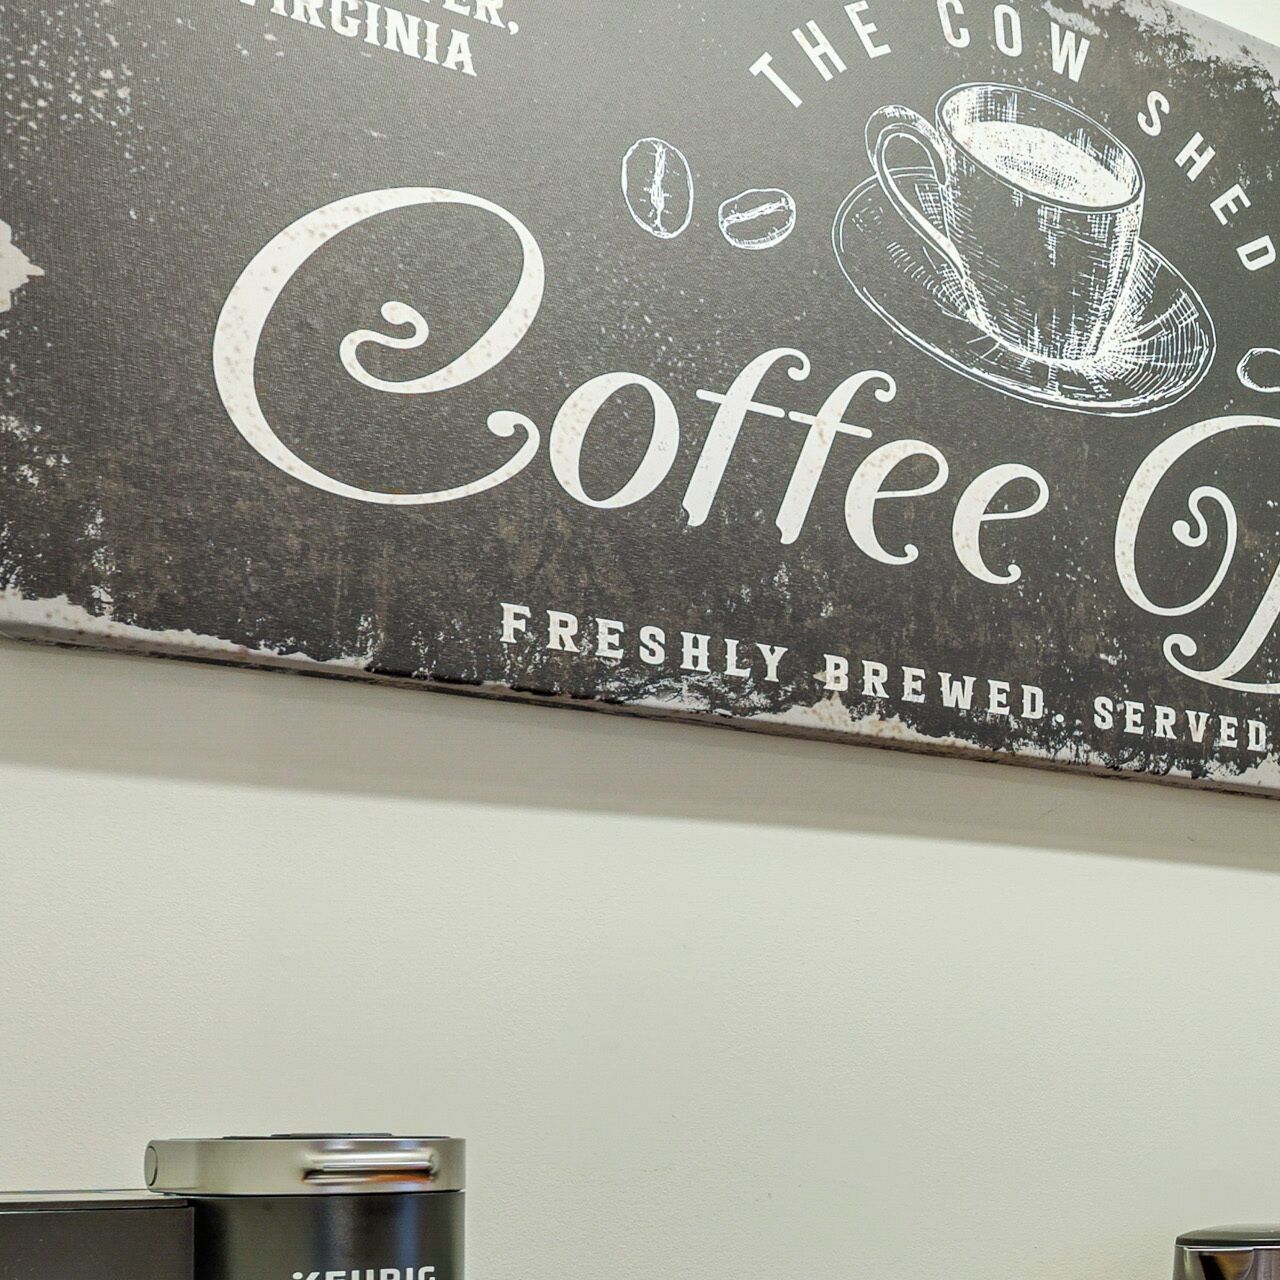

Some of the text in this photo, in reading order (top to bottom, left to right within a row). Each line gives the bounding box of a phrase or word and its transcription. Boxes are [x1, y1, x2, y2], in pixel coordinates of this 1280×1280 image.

[239, 0, 479, 77] RGINIA
[749, 0, 1278, 272] THE COW SHED
[213, 187, 1050, 584] Coffee
[499, 602, 789, 682] FRESHLY
[1093, 696, 1267, 752] SERVED
